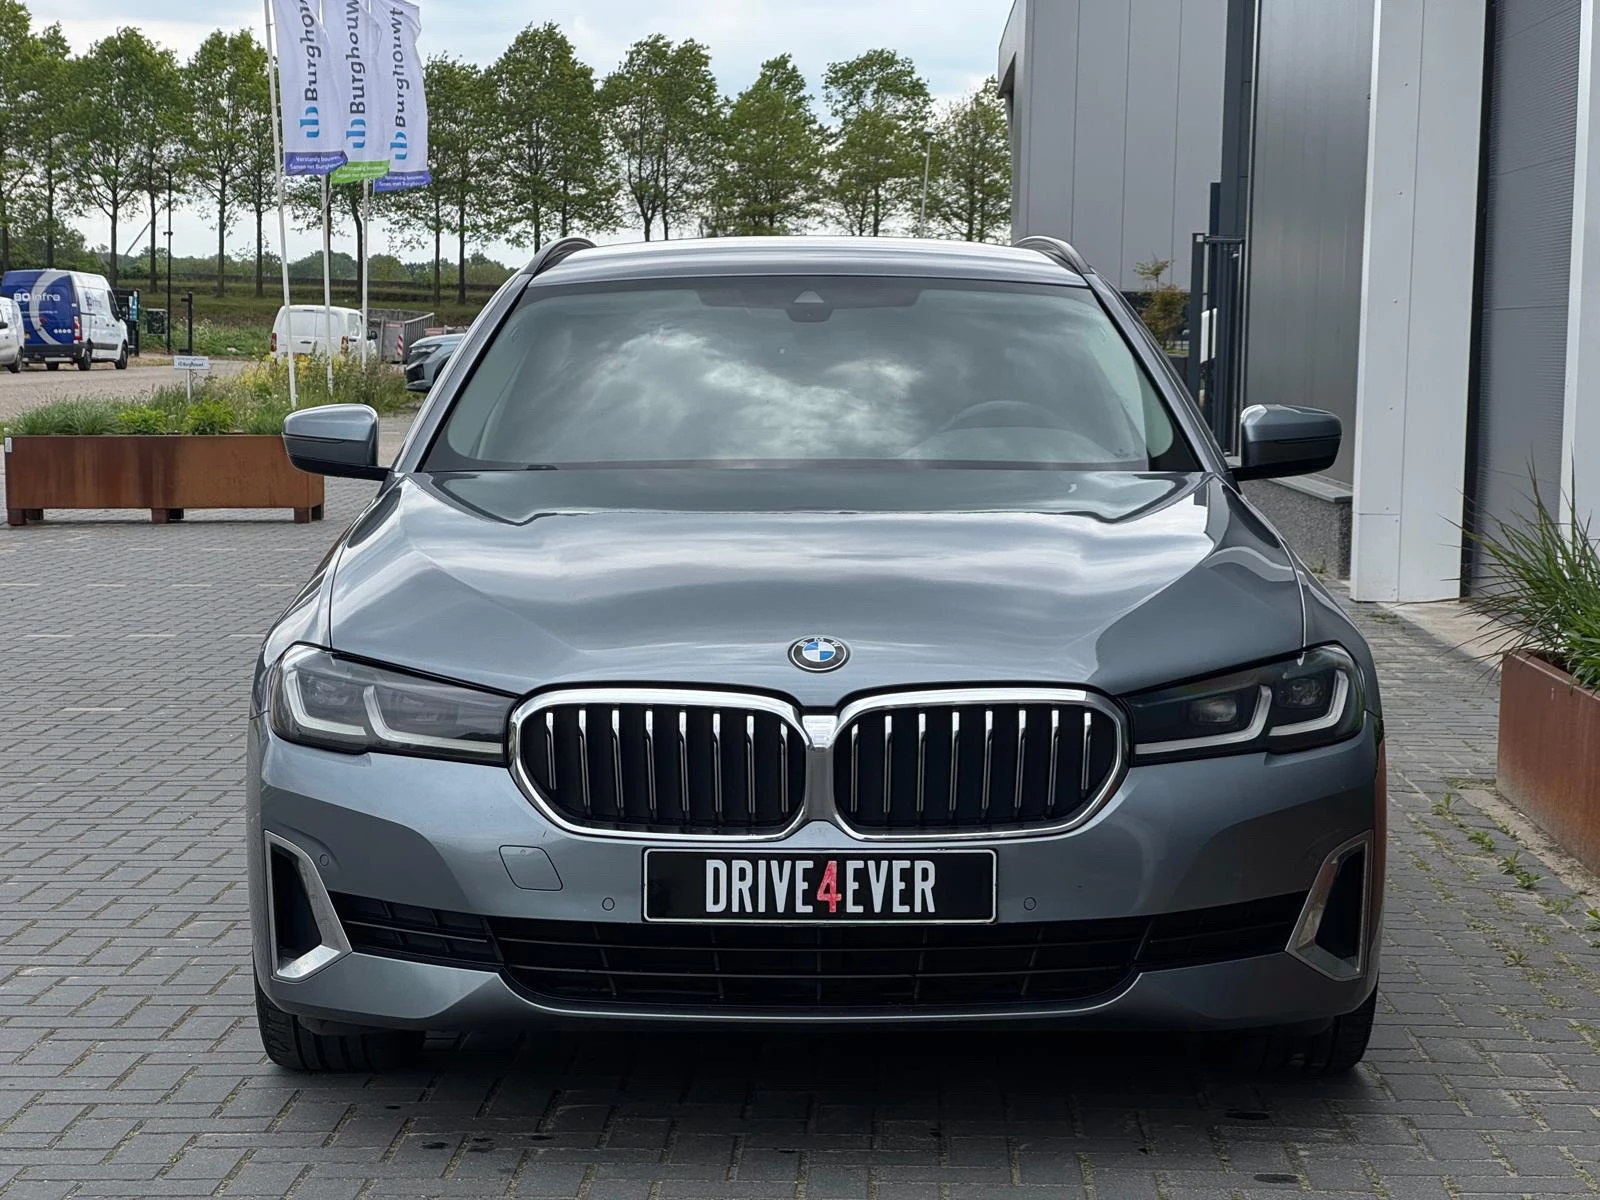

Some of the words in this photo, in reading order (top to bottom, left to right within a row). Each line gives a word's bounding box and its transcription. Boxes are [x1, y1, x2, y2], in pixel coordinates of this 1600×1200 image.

[390, 7, 410, 127] Burghouwt
[797, 637, 841, 647] BMW
[705, 859, 936, 913] DRIVE4EVER
